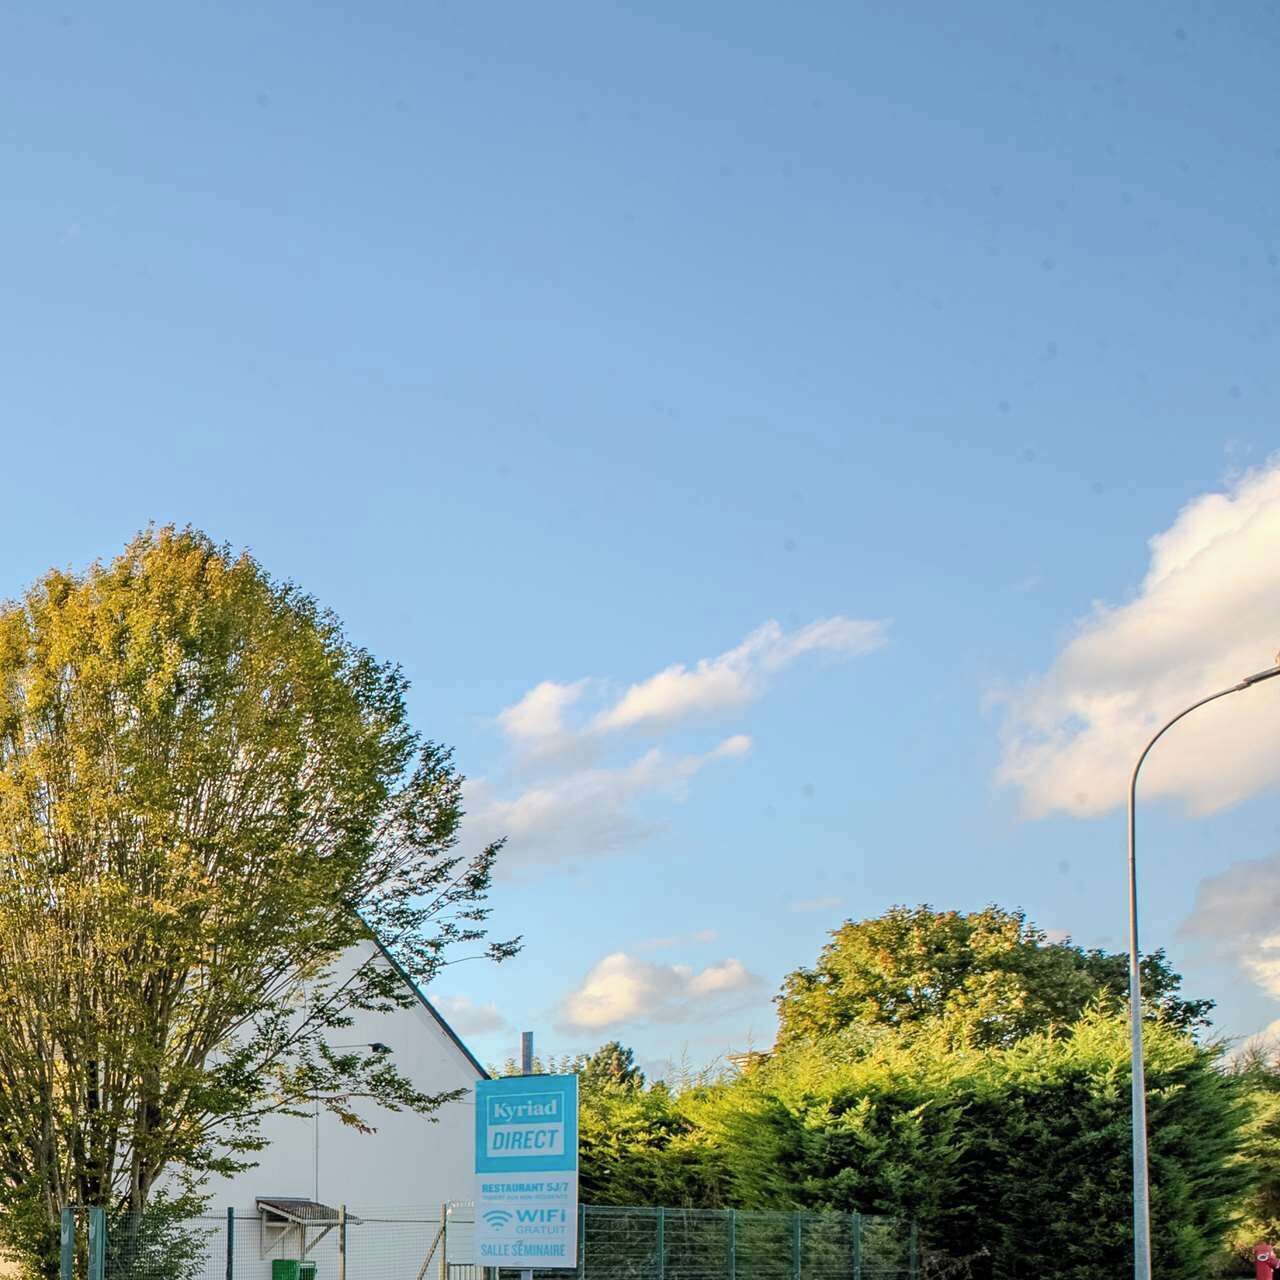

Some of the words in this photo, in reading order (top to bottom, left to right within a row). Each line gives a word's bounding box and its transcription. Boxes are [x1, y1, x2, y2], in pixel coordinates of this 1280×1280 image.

[494, 1099, 558, 1122] Kyriad
[492, 1129, 559, 1150] DIRECT
[481, 1183, 544, 1193] RESTAURANT
[515, 1225, 568, 1234] GRATUIT
[481, 1244, 510, 1257] SALLE
